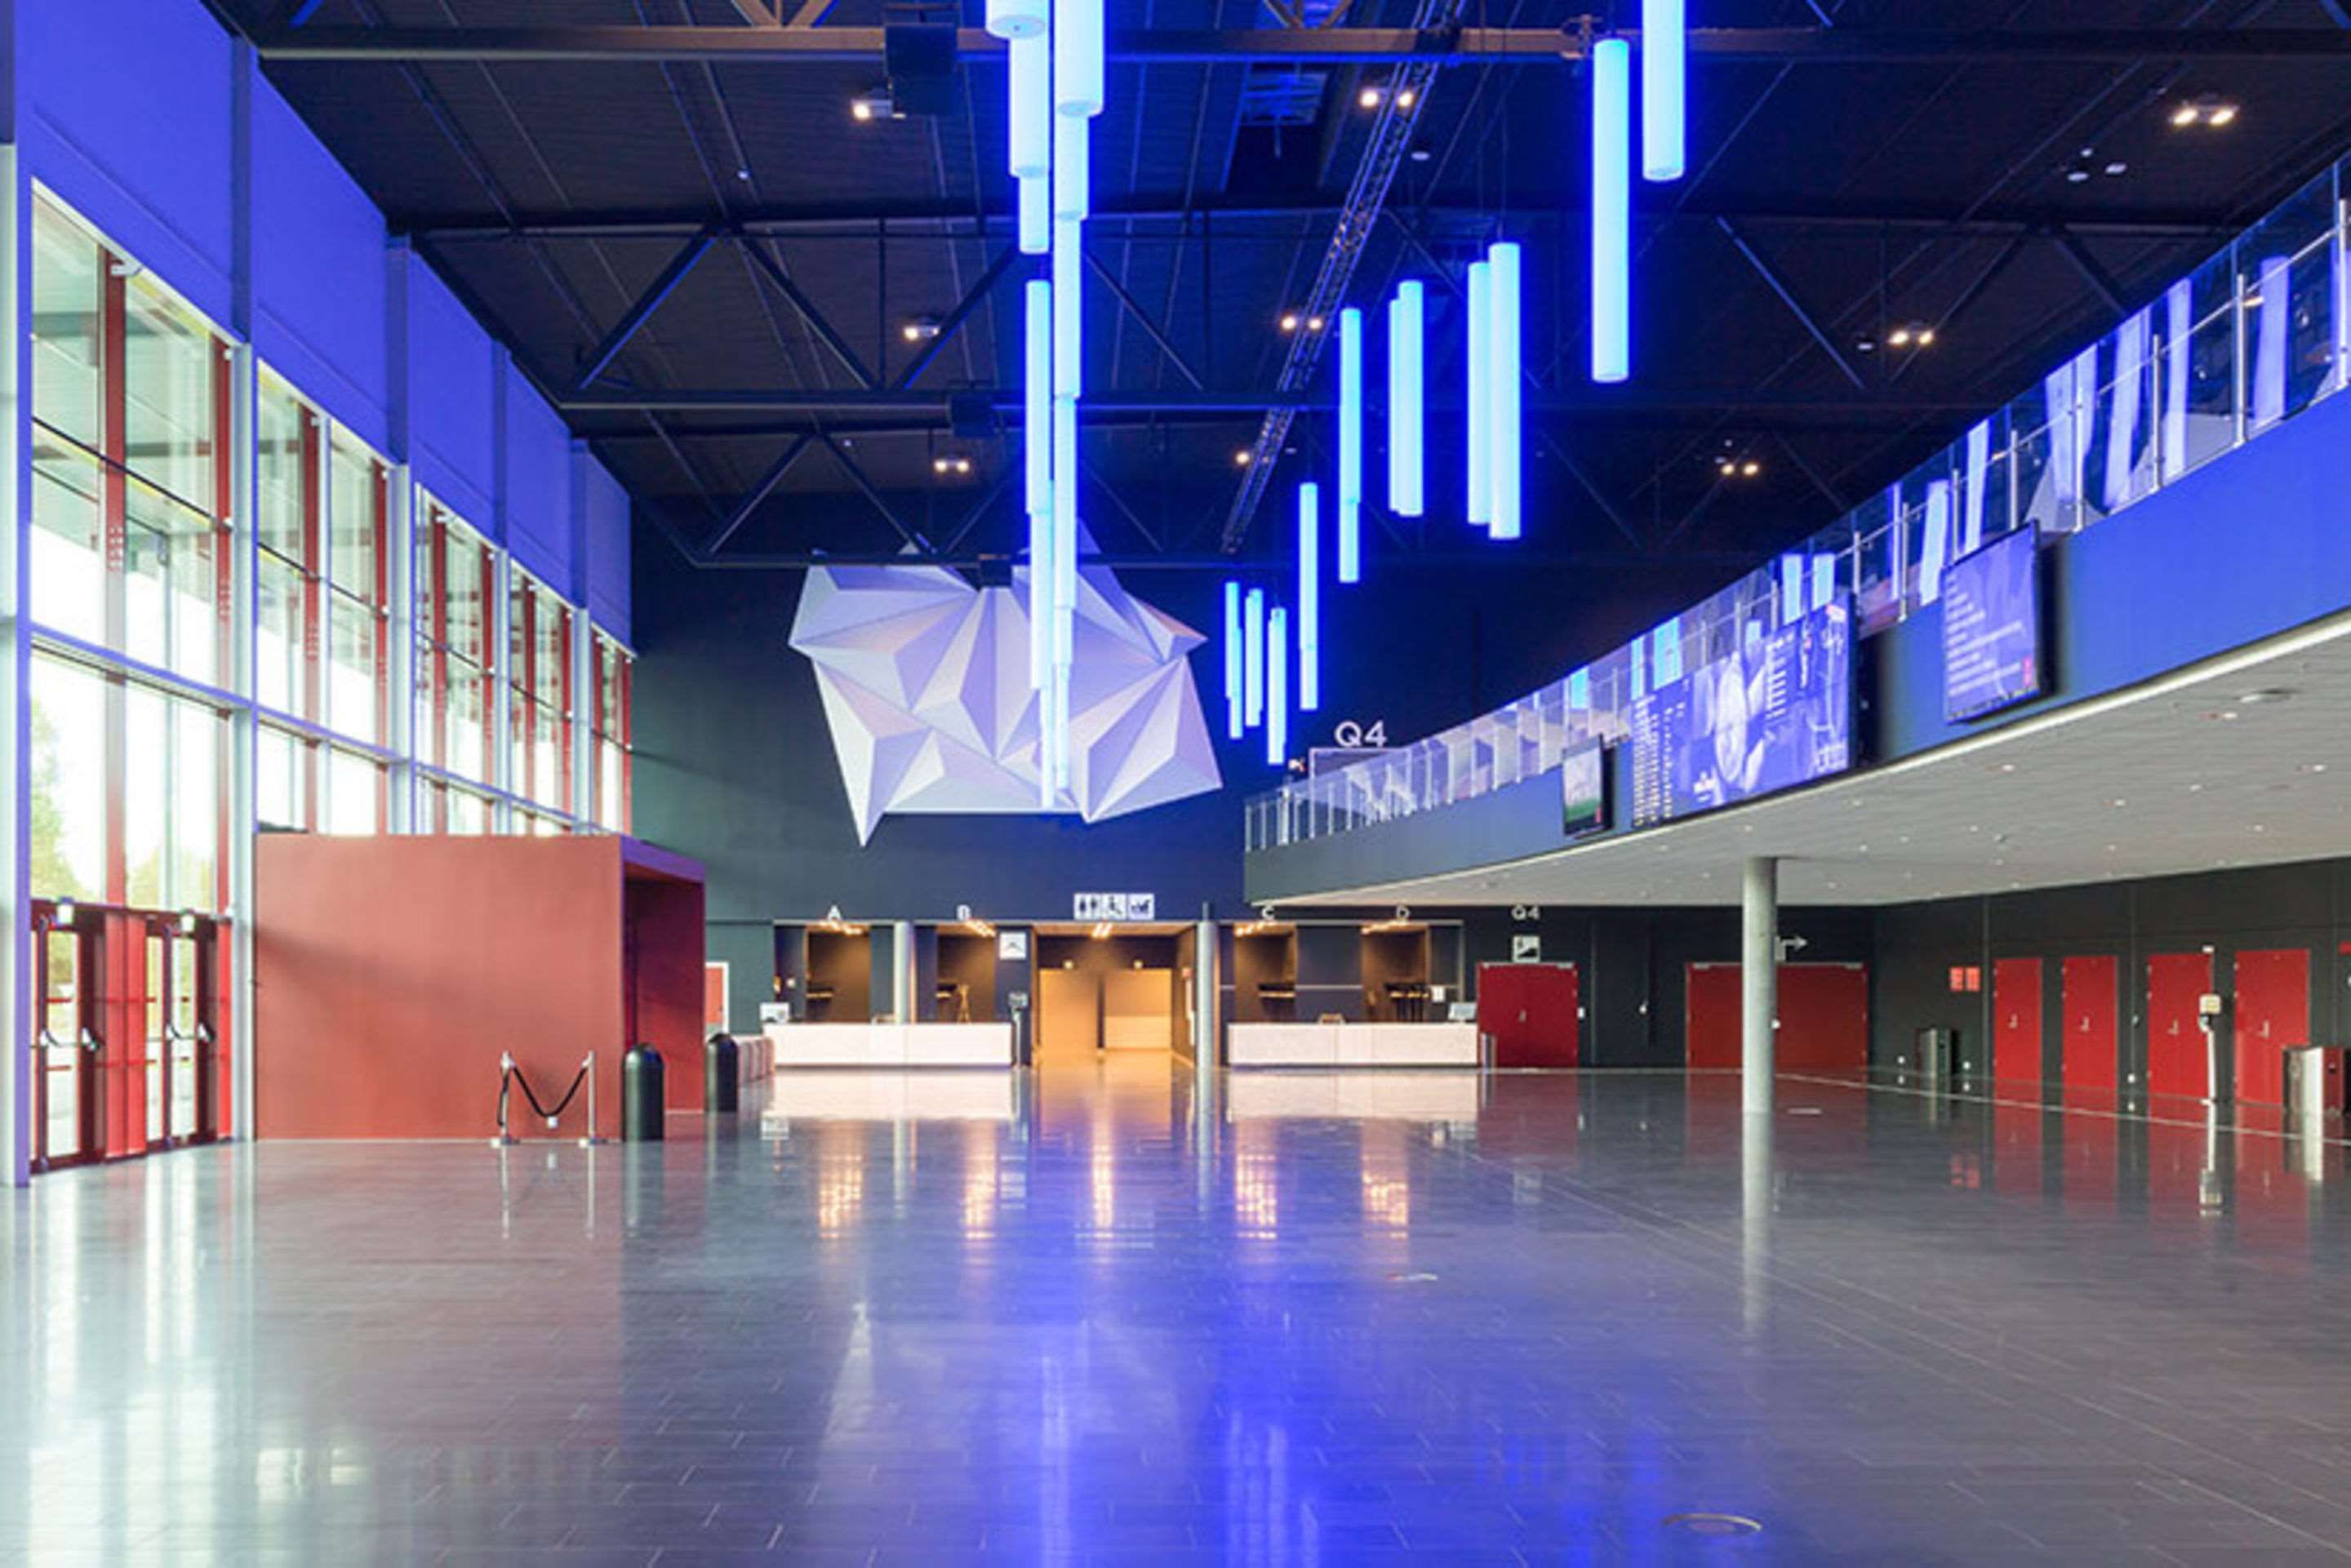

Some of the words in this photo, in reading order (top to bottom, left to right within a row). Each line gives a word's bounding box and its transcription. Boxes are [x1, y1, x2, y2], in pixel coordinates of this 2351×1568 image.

[1334, 720, 1387, 748] Q4
[827, 904, 842, 922] A
[1261, 903, 1275, 921] C
[1396, 903, 1410, 921] D
[1510, 904, 1540, 921] Q4
